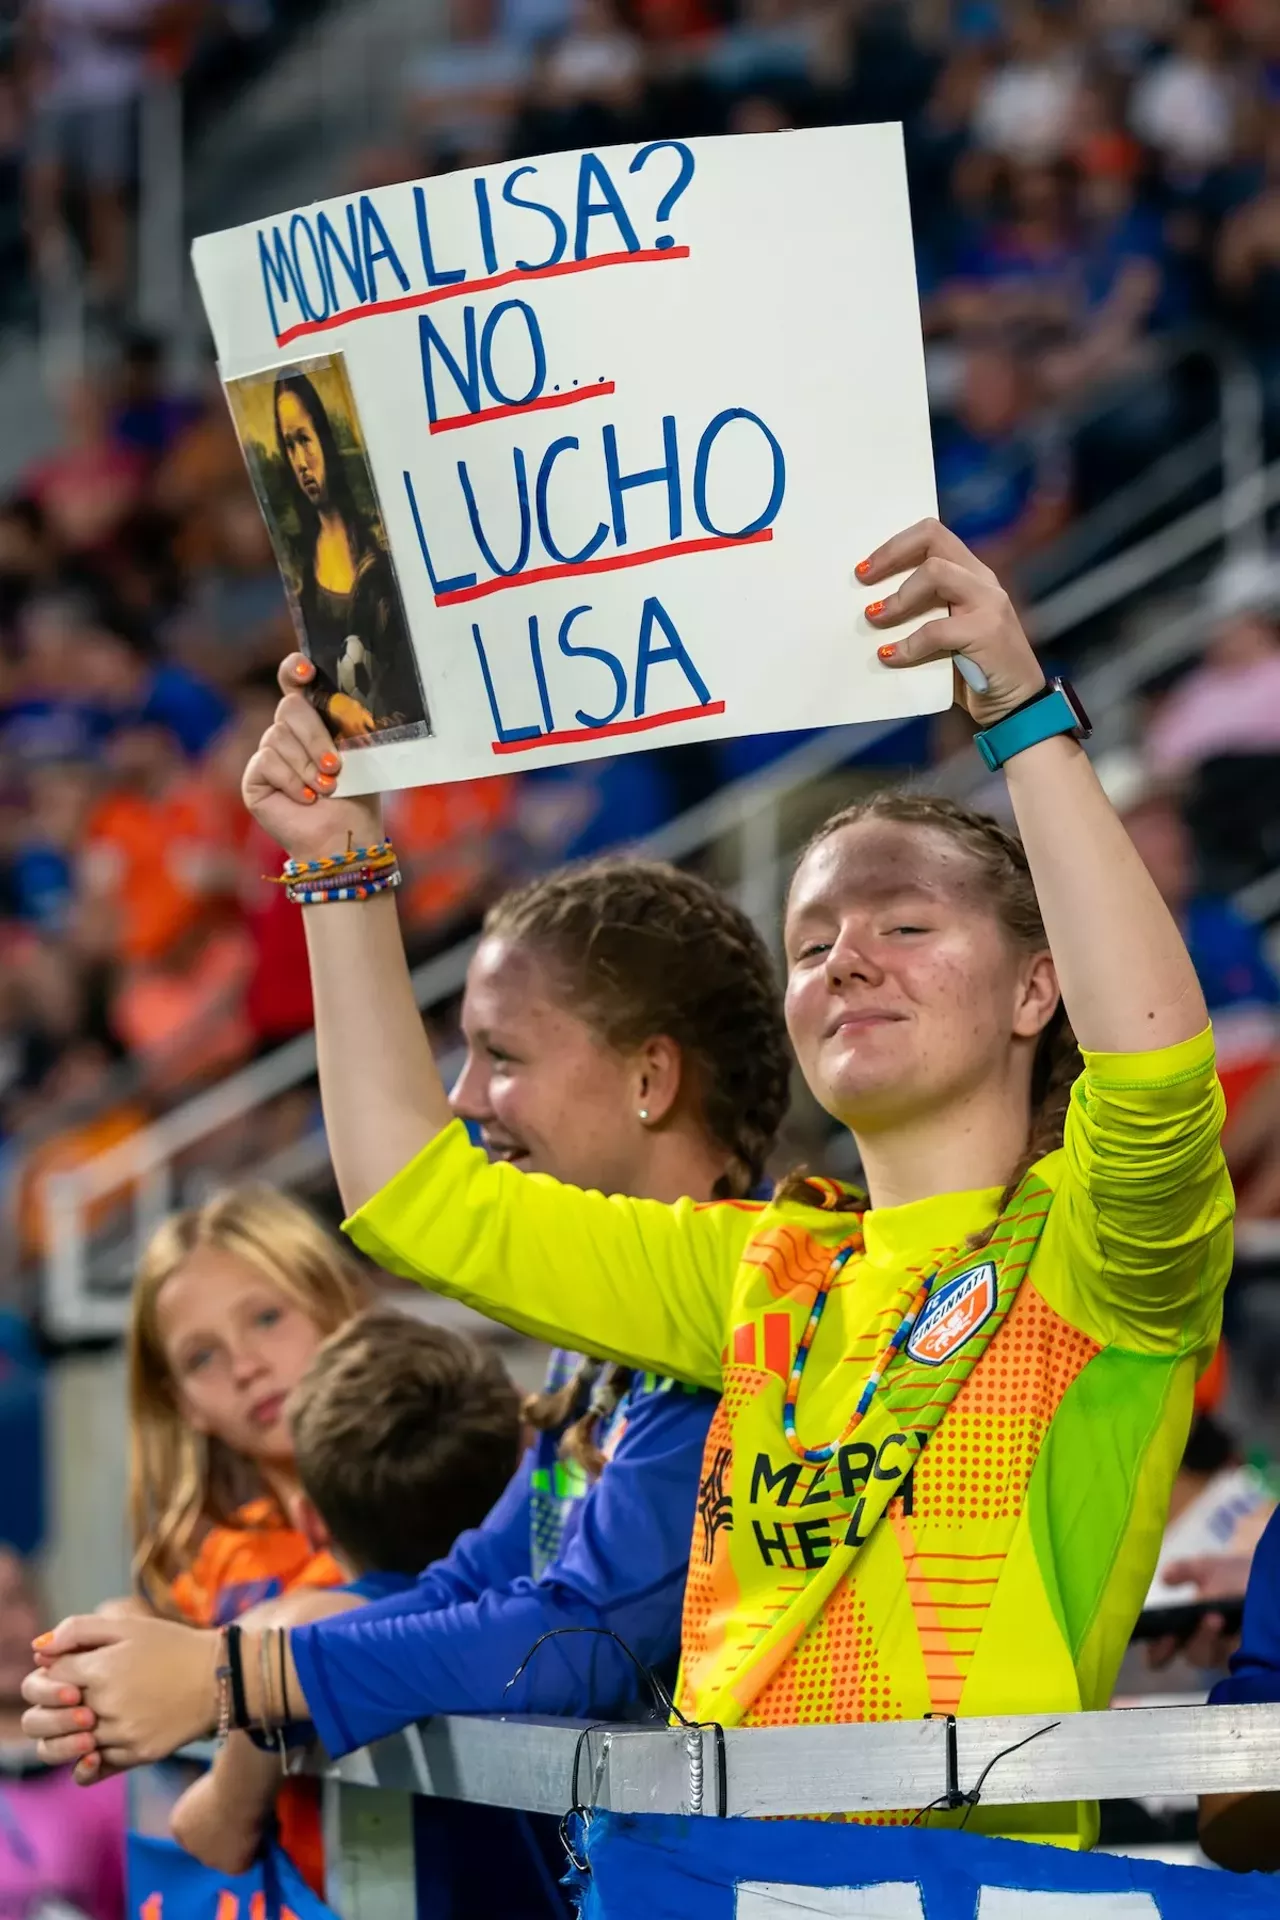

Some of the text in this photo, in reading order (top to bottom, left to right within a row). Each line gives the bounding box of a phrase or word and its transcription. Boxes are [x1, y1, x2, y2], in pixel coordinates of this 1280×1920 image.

[258, 141, 696, 337] MONA LISA?
[418, 298, 606, 422] NO...
[403, 407, 786, 594] LUCHO
[471, 596, 712, 743] LISA
[911, 1268, 986, 1347] CINCINNATI
